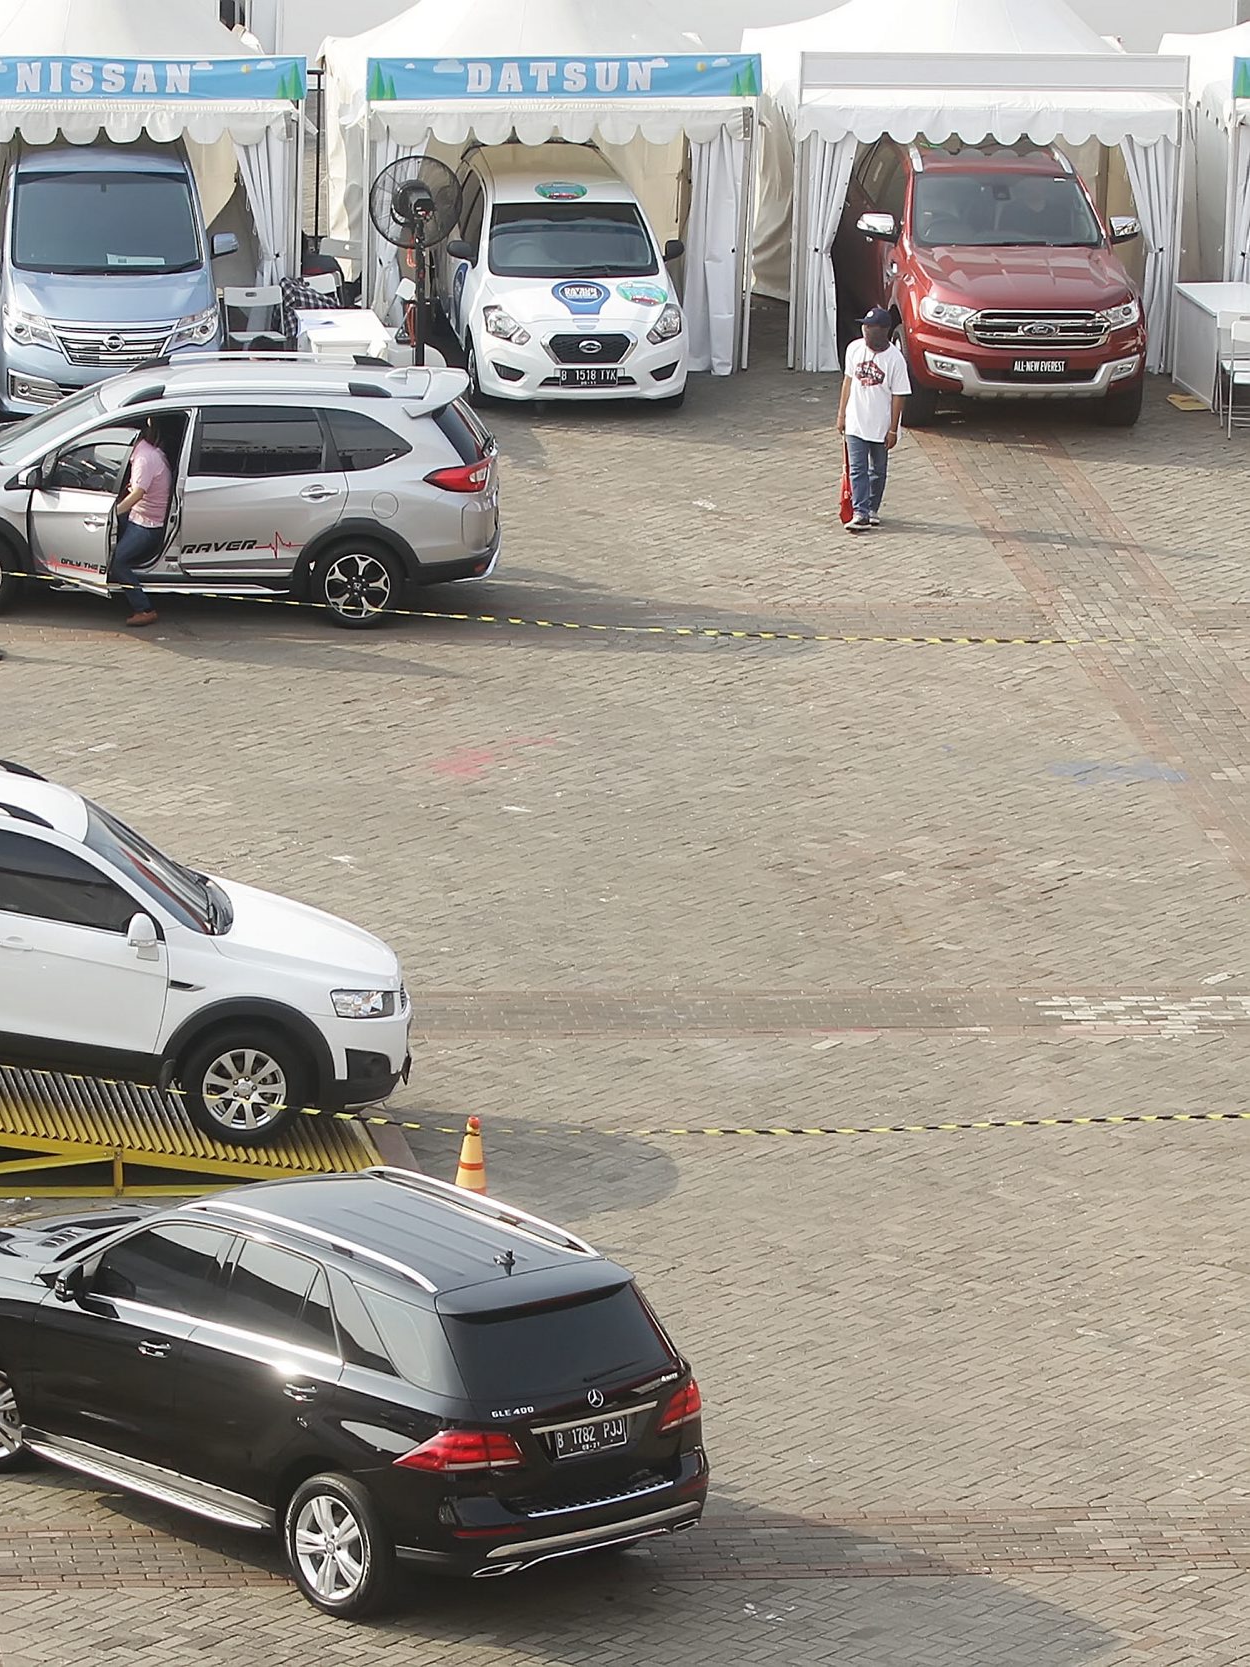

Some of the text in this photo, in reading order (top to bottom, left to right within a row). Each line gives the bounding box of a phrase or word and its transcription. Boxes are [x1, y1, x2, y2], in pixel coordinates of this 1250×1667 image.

[16, 62, 191, 93] NISSAN
[466, 61, 652, 93] DATSUN
[1013, 360, 1065, 372] ALL-NEW EVEREST
[575, 370, 597, 381] 1518
[600, 369, 617, 380] TYK
[181, 539, 257, 555] RAVER
[491, 1406, 534, 1418] GLE 400
[556, 1419, 623, 1449] B 1782 PJJ
